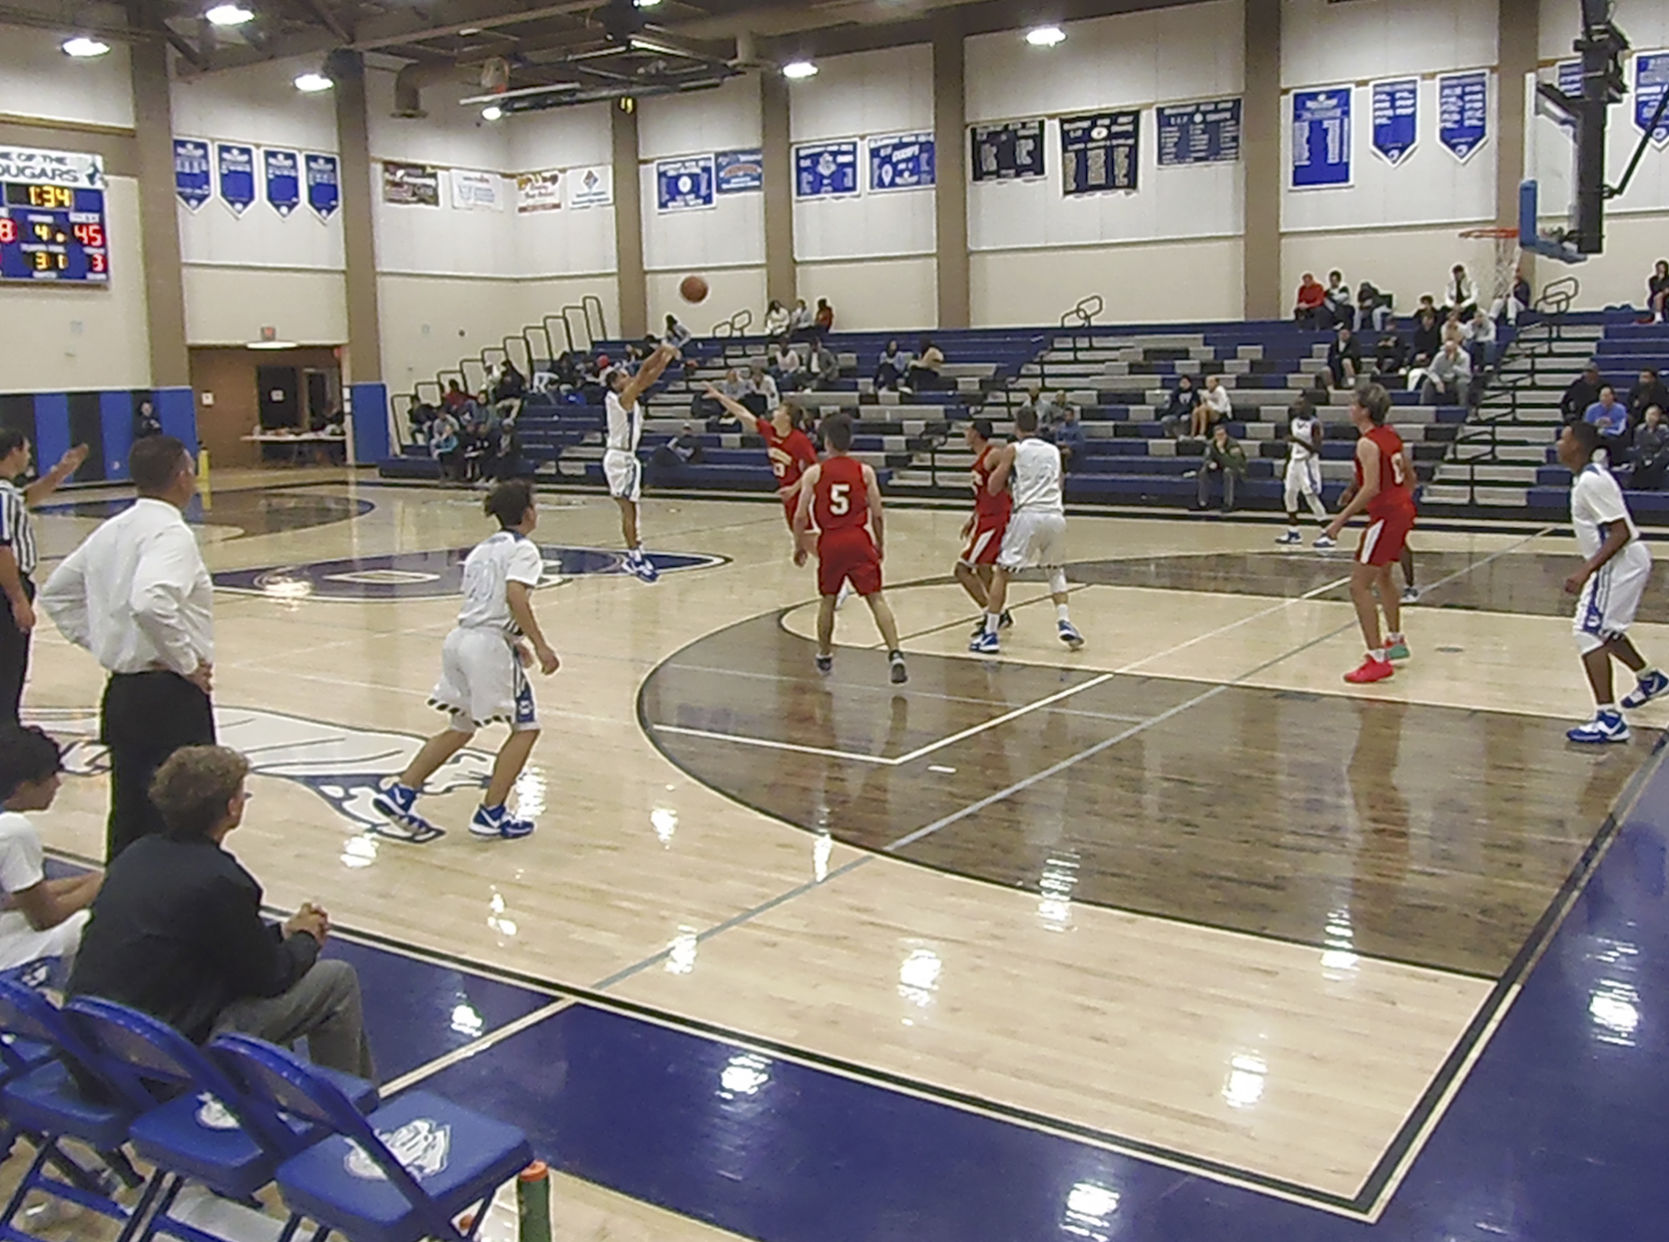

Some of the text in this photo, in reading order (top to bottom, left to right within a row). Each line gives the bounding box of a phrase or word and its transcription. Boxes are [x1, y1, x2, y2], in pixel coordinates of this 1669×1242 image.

[29, 184, 71, 208] 1:34
[34, 223, 48, 241] 4
[74, 224, 103, 247] 45
[92, 253, 105, 272] 3
[830, 483, 850, 515] 5
